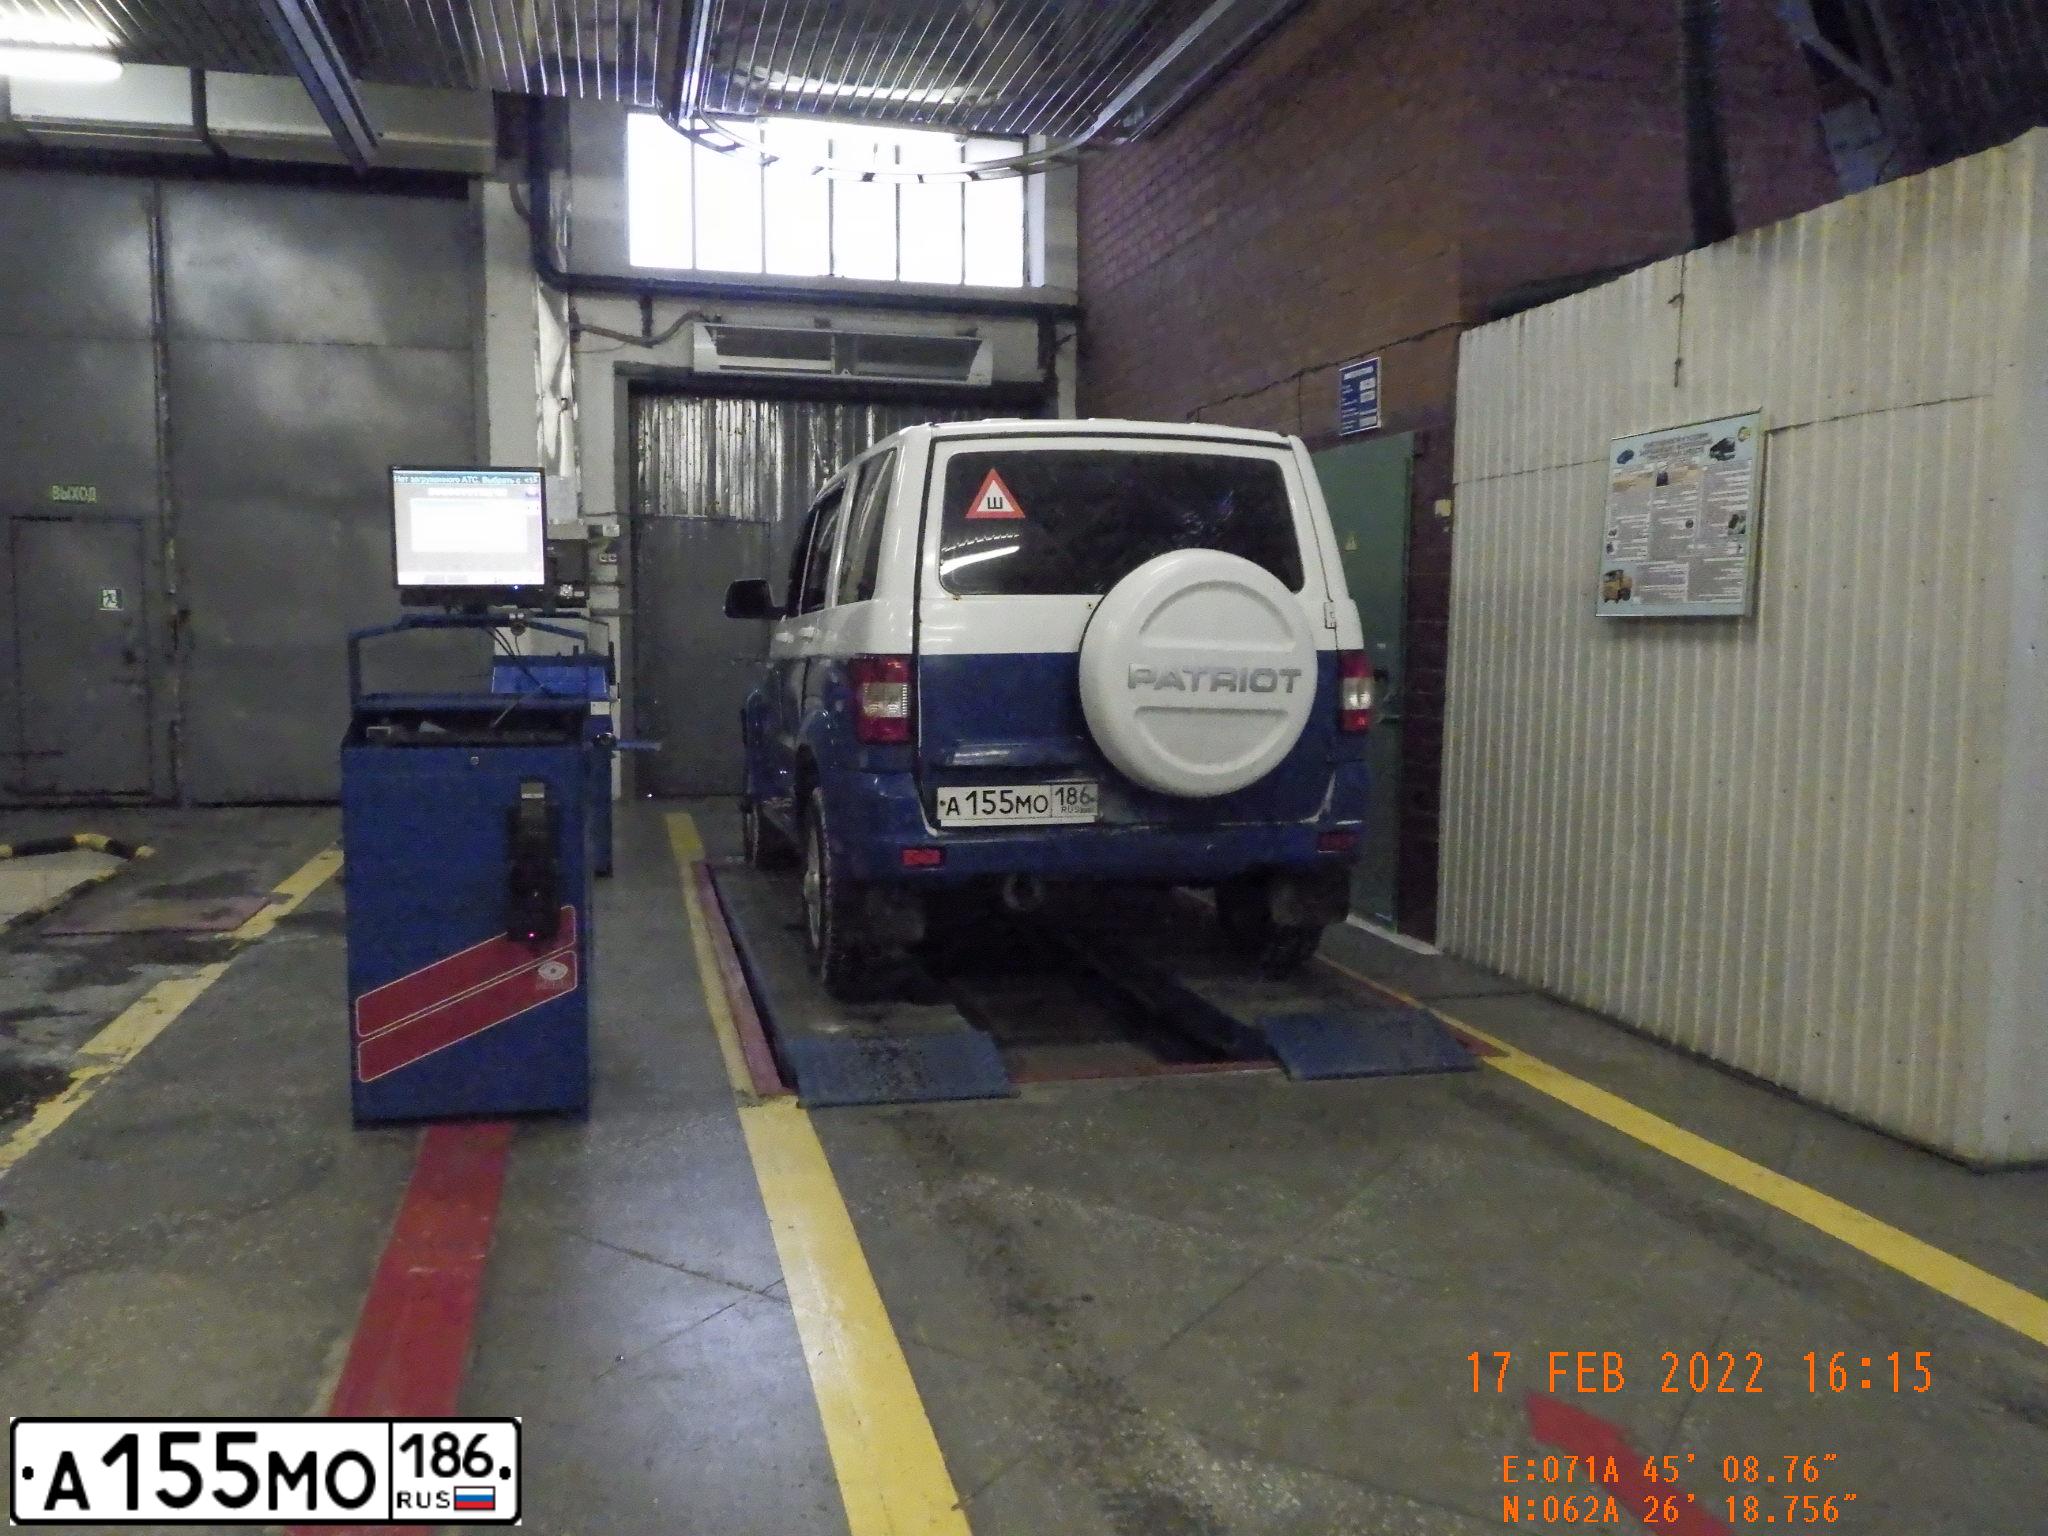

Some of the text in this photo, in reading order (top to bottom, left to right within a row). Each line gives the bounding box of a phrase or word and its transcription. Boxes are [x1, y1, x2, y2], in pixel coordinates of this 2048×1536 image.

[51, 485, 97, 503] ВЫХОД
[987, 496, 1004, 510] Ш
[1127, 663, 1303, 693] PATRIOT
[1055, 786, 1091, 805] 186
